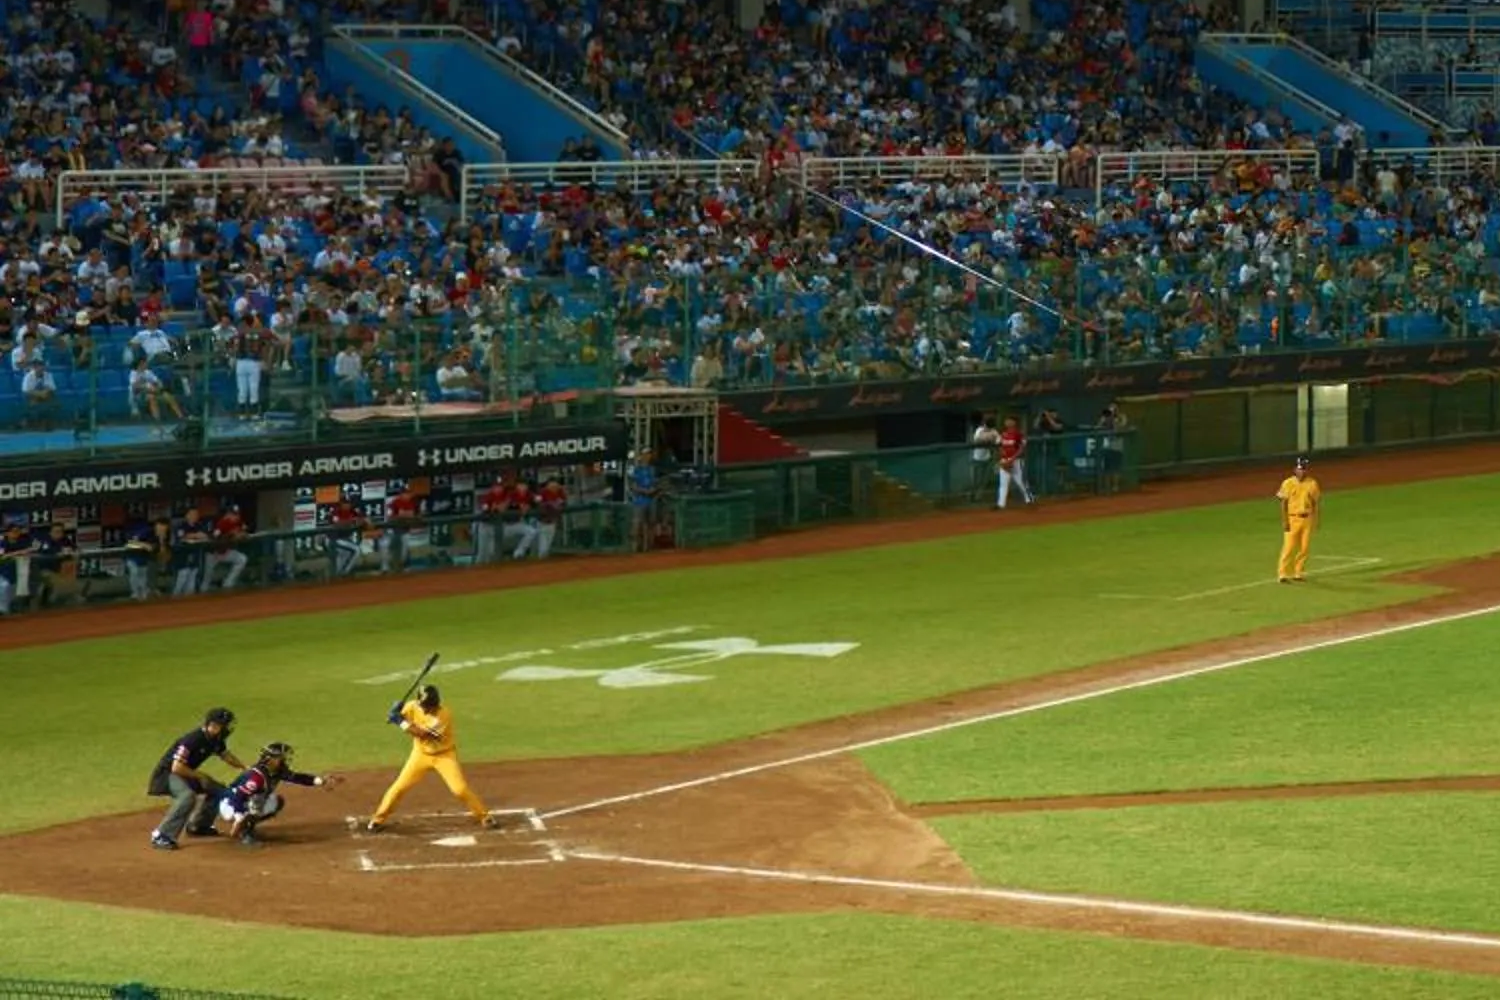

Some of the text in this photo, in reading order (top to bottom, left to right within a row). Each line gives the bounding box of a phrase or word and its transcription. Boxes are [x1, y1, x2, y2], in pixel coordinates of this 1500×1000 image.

[444, 436, 607, 463] UNDER ARMOUR
[216, 452, 394, 483] UNDER ARMOUR
[0, 474, 158, 500] DER ARMOUR
